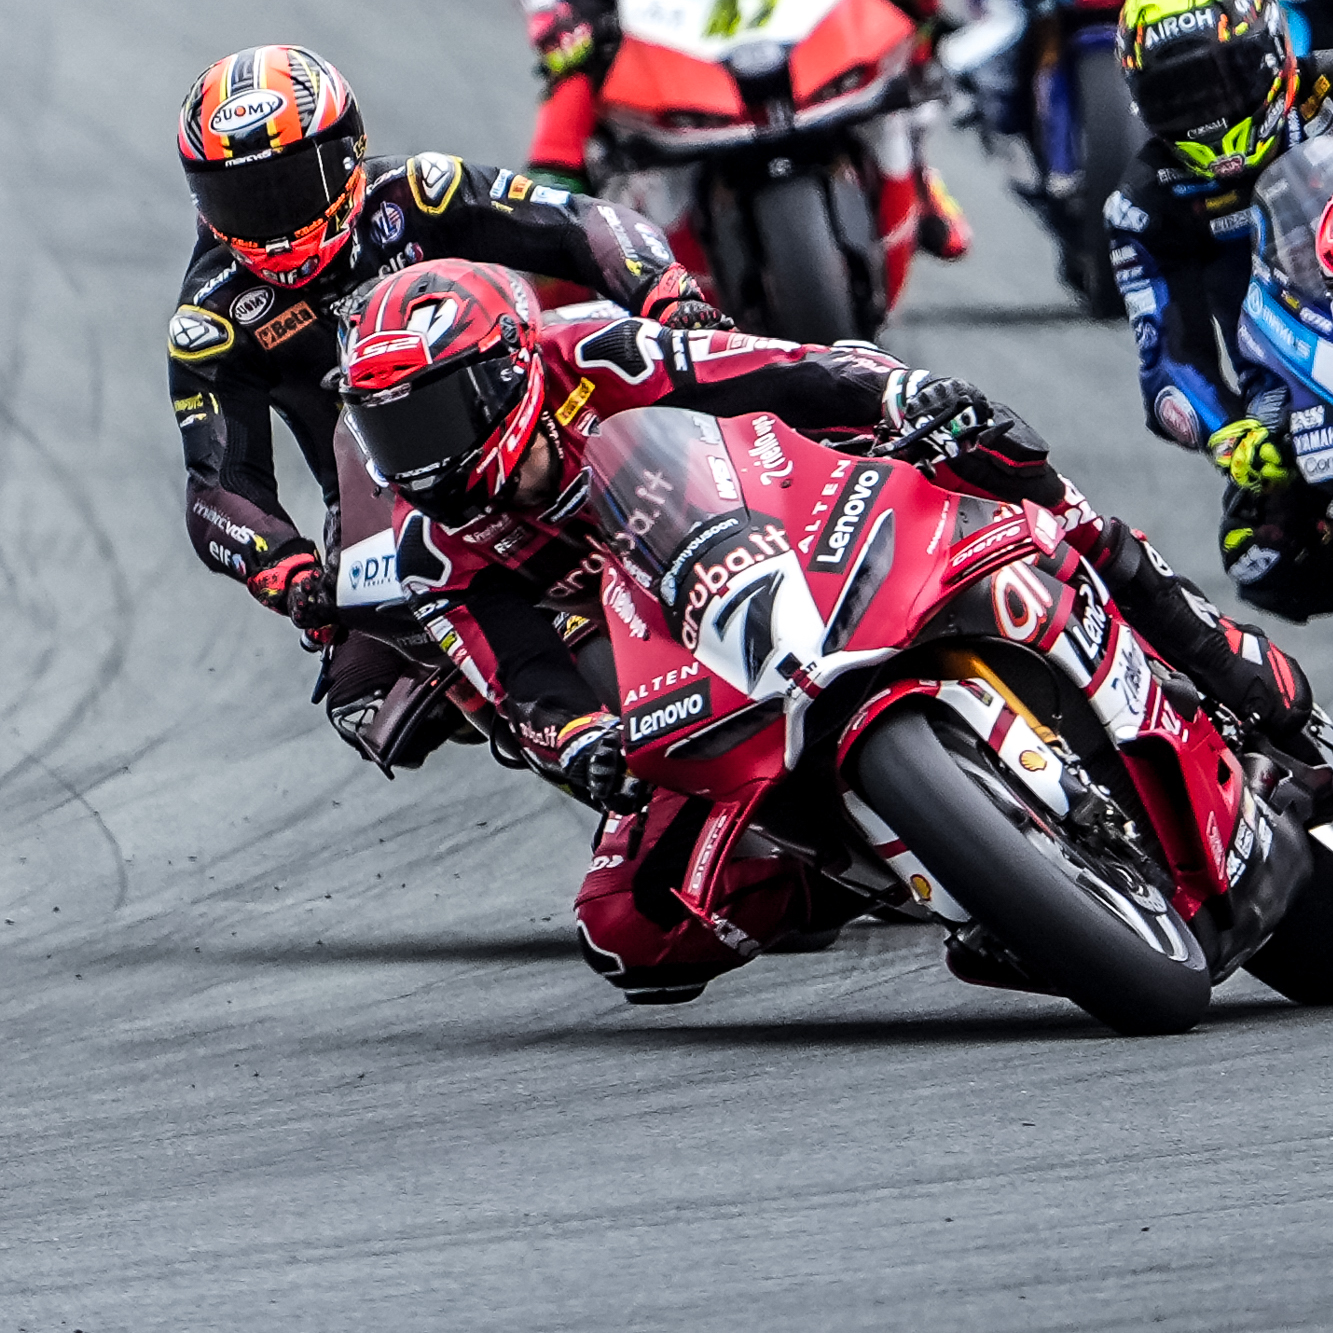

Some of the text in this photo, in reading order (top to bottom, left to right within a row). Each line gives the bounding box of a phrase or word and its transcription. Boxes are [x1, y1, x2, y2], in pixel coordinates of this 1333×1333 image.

[1144, 7, 1215, 50] AIROH
[212, 99, 278, 125] SUOMY
[233, 293, 272, 319] SUOMY
[275, 308, 315, 339] Beta
[352, 336, 421, 365] LS2
[798, 459, 851, 555] ALTEN
[814, 468, 881, 565] Lenovo
[208, 541, 232, 565] elf
[951, 523, 1022, 568] Dierre
[680, 523, 792, 651] aruba.it
[711, 568, 786, 698] 7
[622, 661, 699, 707] ALTEN
[628, 692, 704, 742] Lenovo
